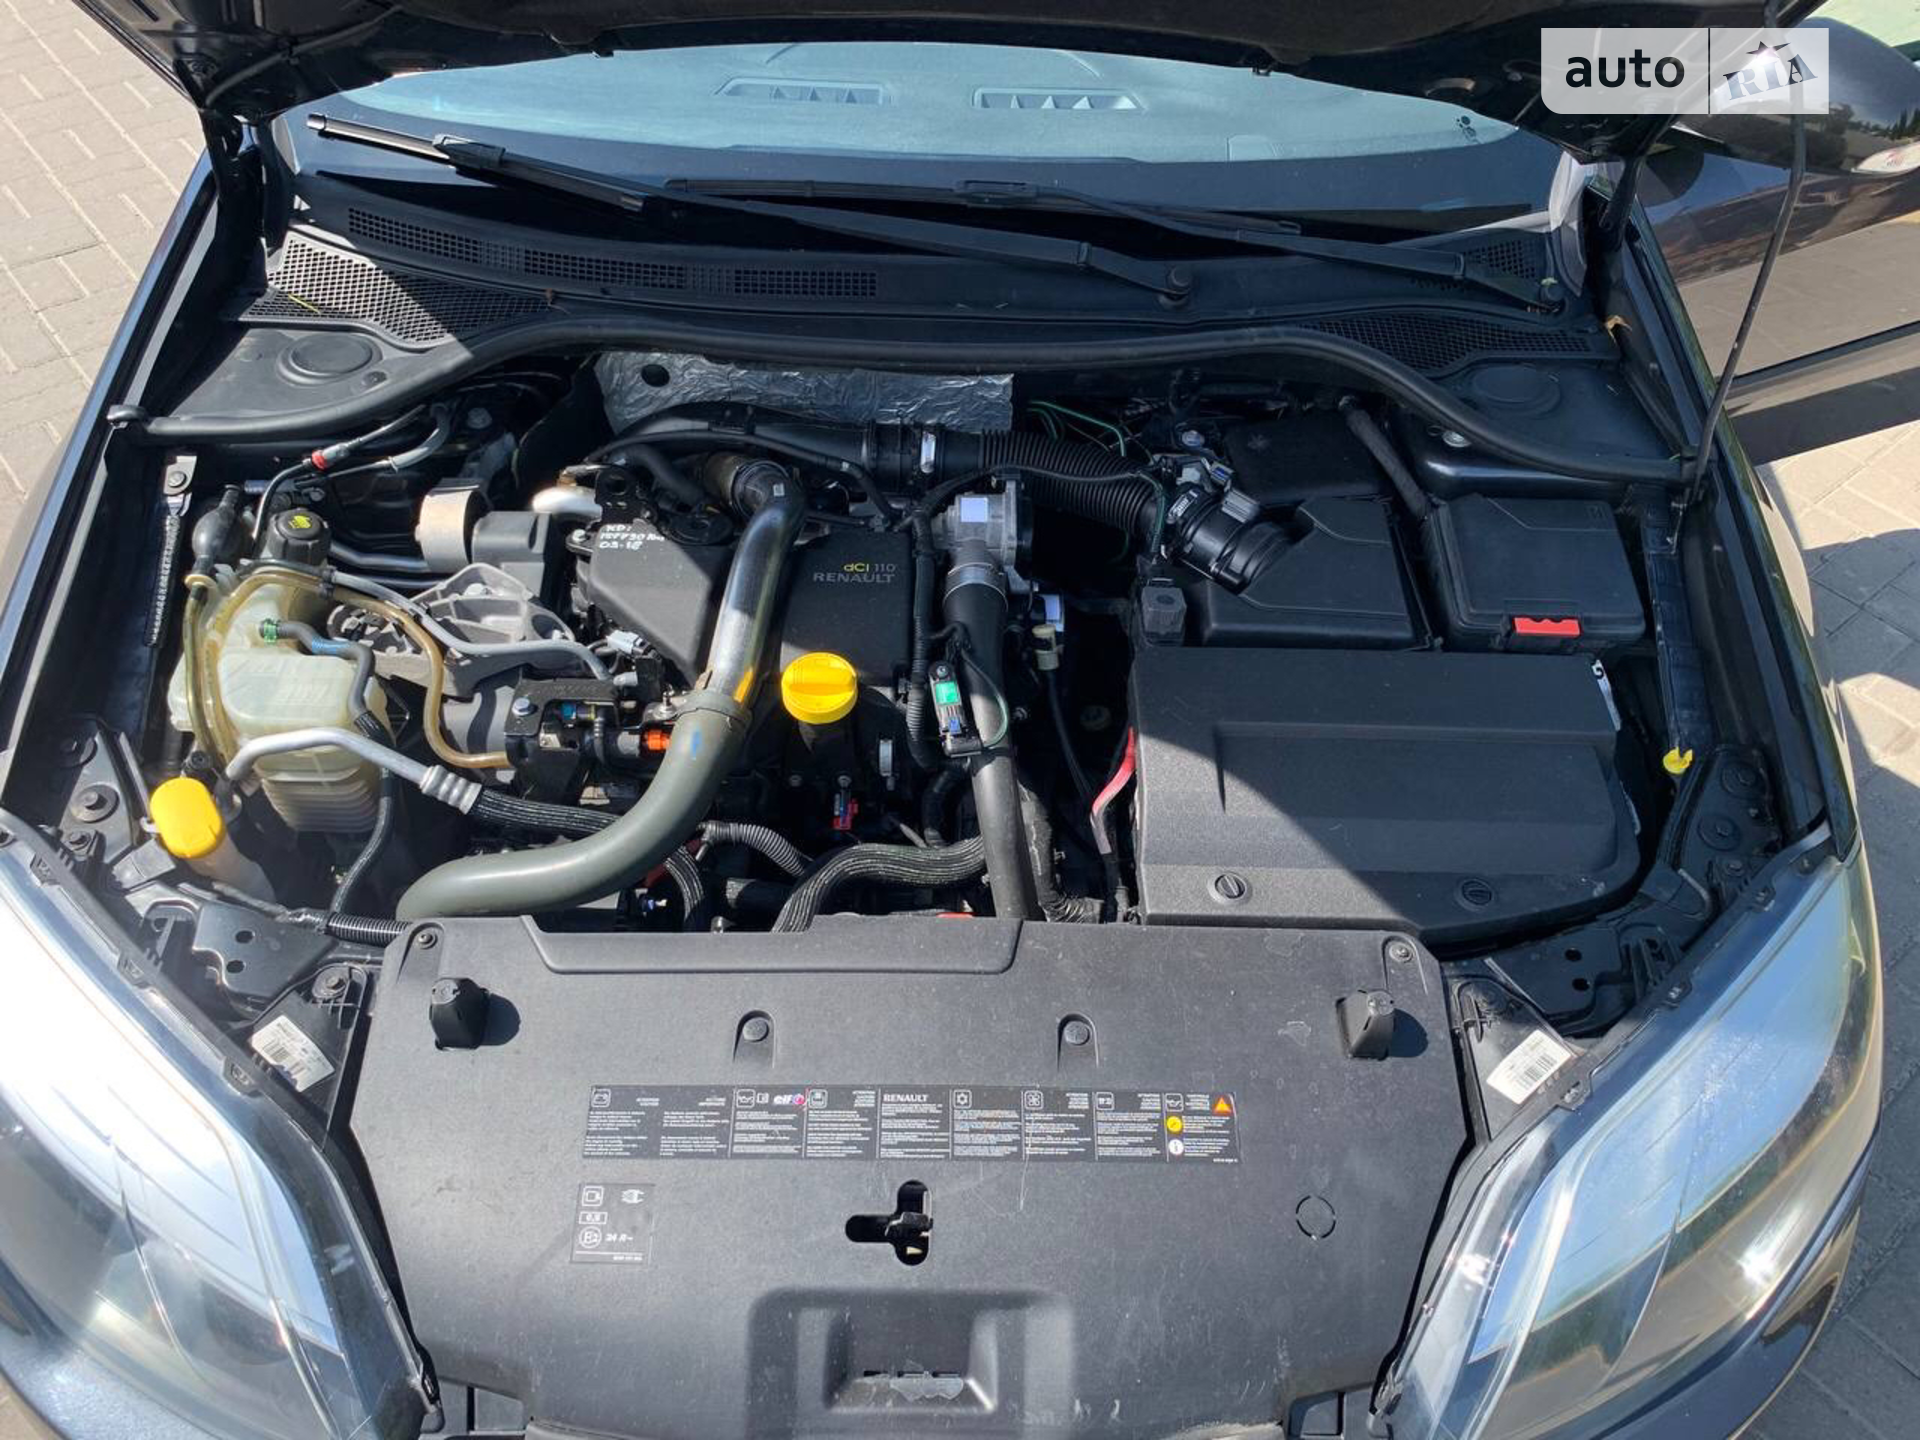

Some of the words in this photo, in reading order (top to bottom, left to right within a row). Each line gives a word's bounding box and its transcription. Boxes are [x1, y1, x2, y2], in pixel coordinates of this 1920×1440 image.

[874, 563, 897, 573] 110
[813, 572, 896, 584] RENAULT
[773, 1094, 794, 1105] elf
[883, 1093, 929, 1103] RENAULT
